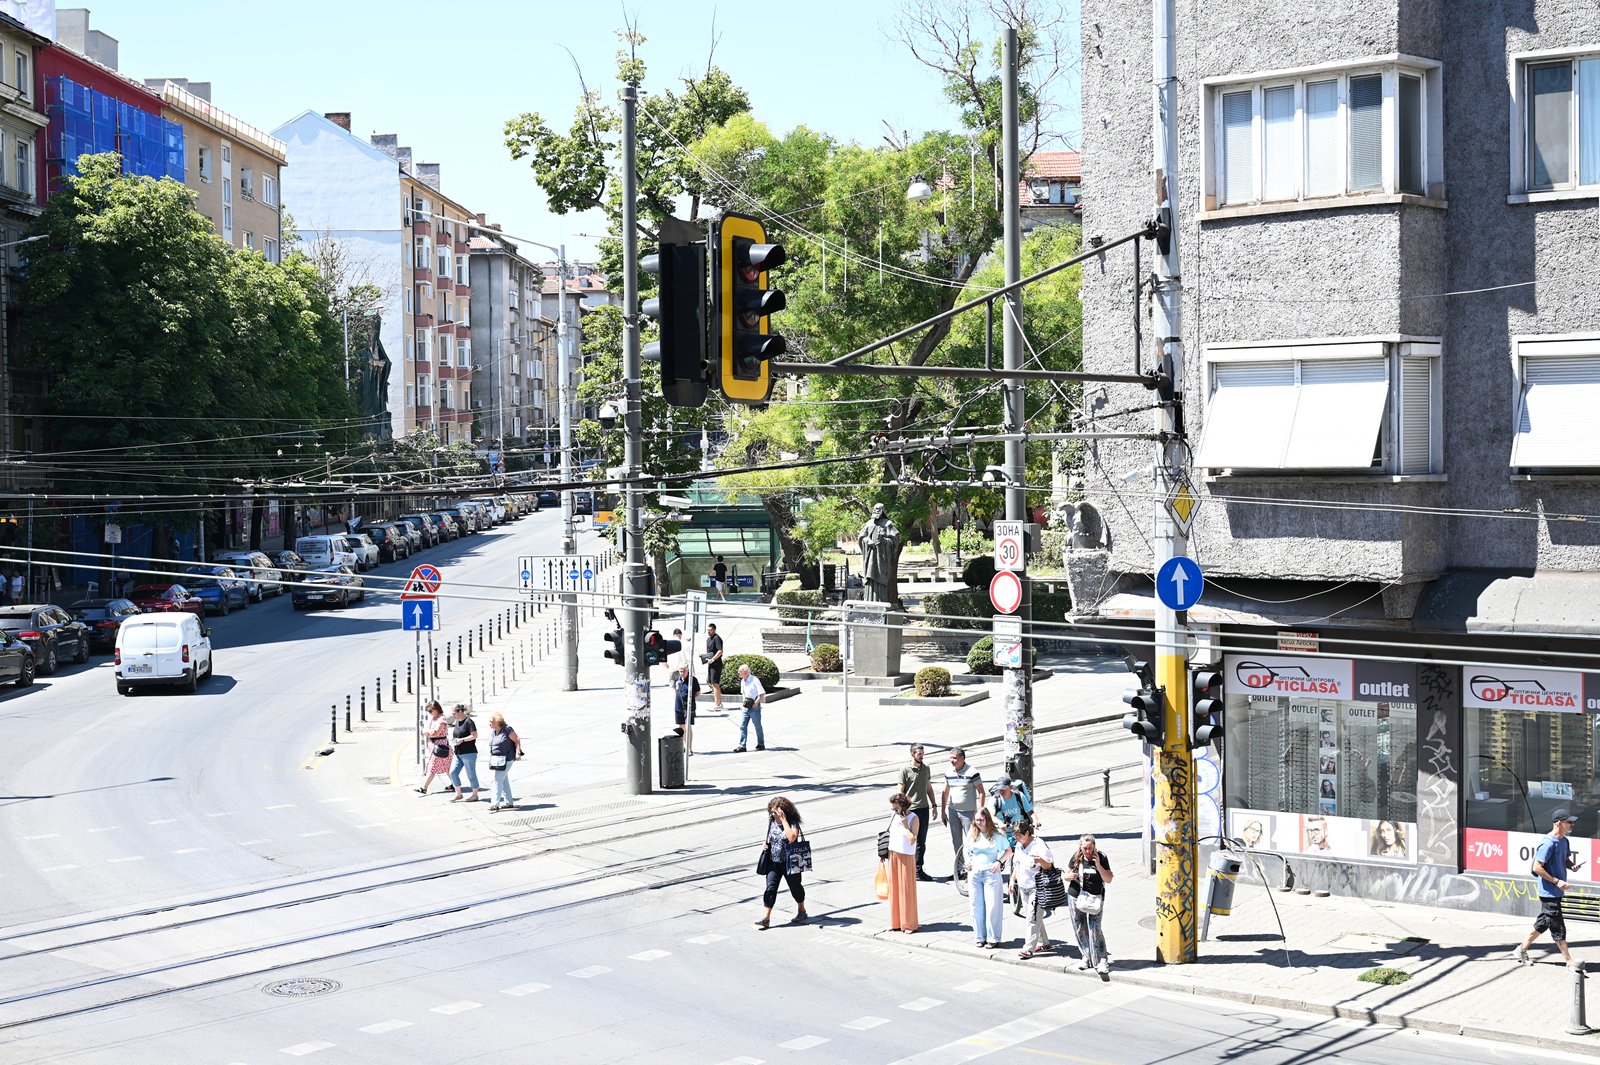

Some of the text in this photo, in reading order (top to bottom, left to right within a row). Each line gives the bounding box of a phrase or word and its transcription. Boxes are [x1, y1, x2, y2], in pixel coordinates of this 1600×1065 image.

[996, 525, 1020, 536] ЗОНА
[1002, 545, 1015, 560] 30
[1247, 674, 1339, 694] OPTICLASA
[1359, 682, 1410, 698] outlet
[1481, 687, 1576, 707] OPTICLASA
[1291, 704, 1318, 714] OUTLET
[1349, 708, 1376, 718] OUTLET
